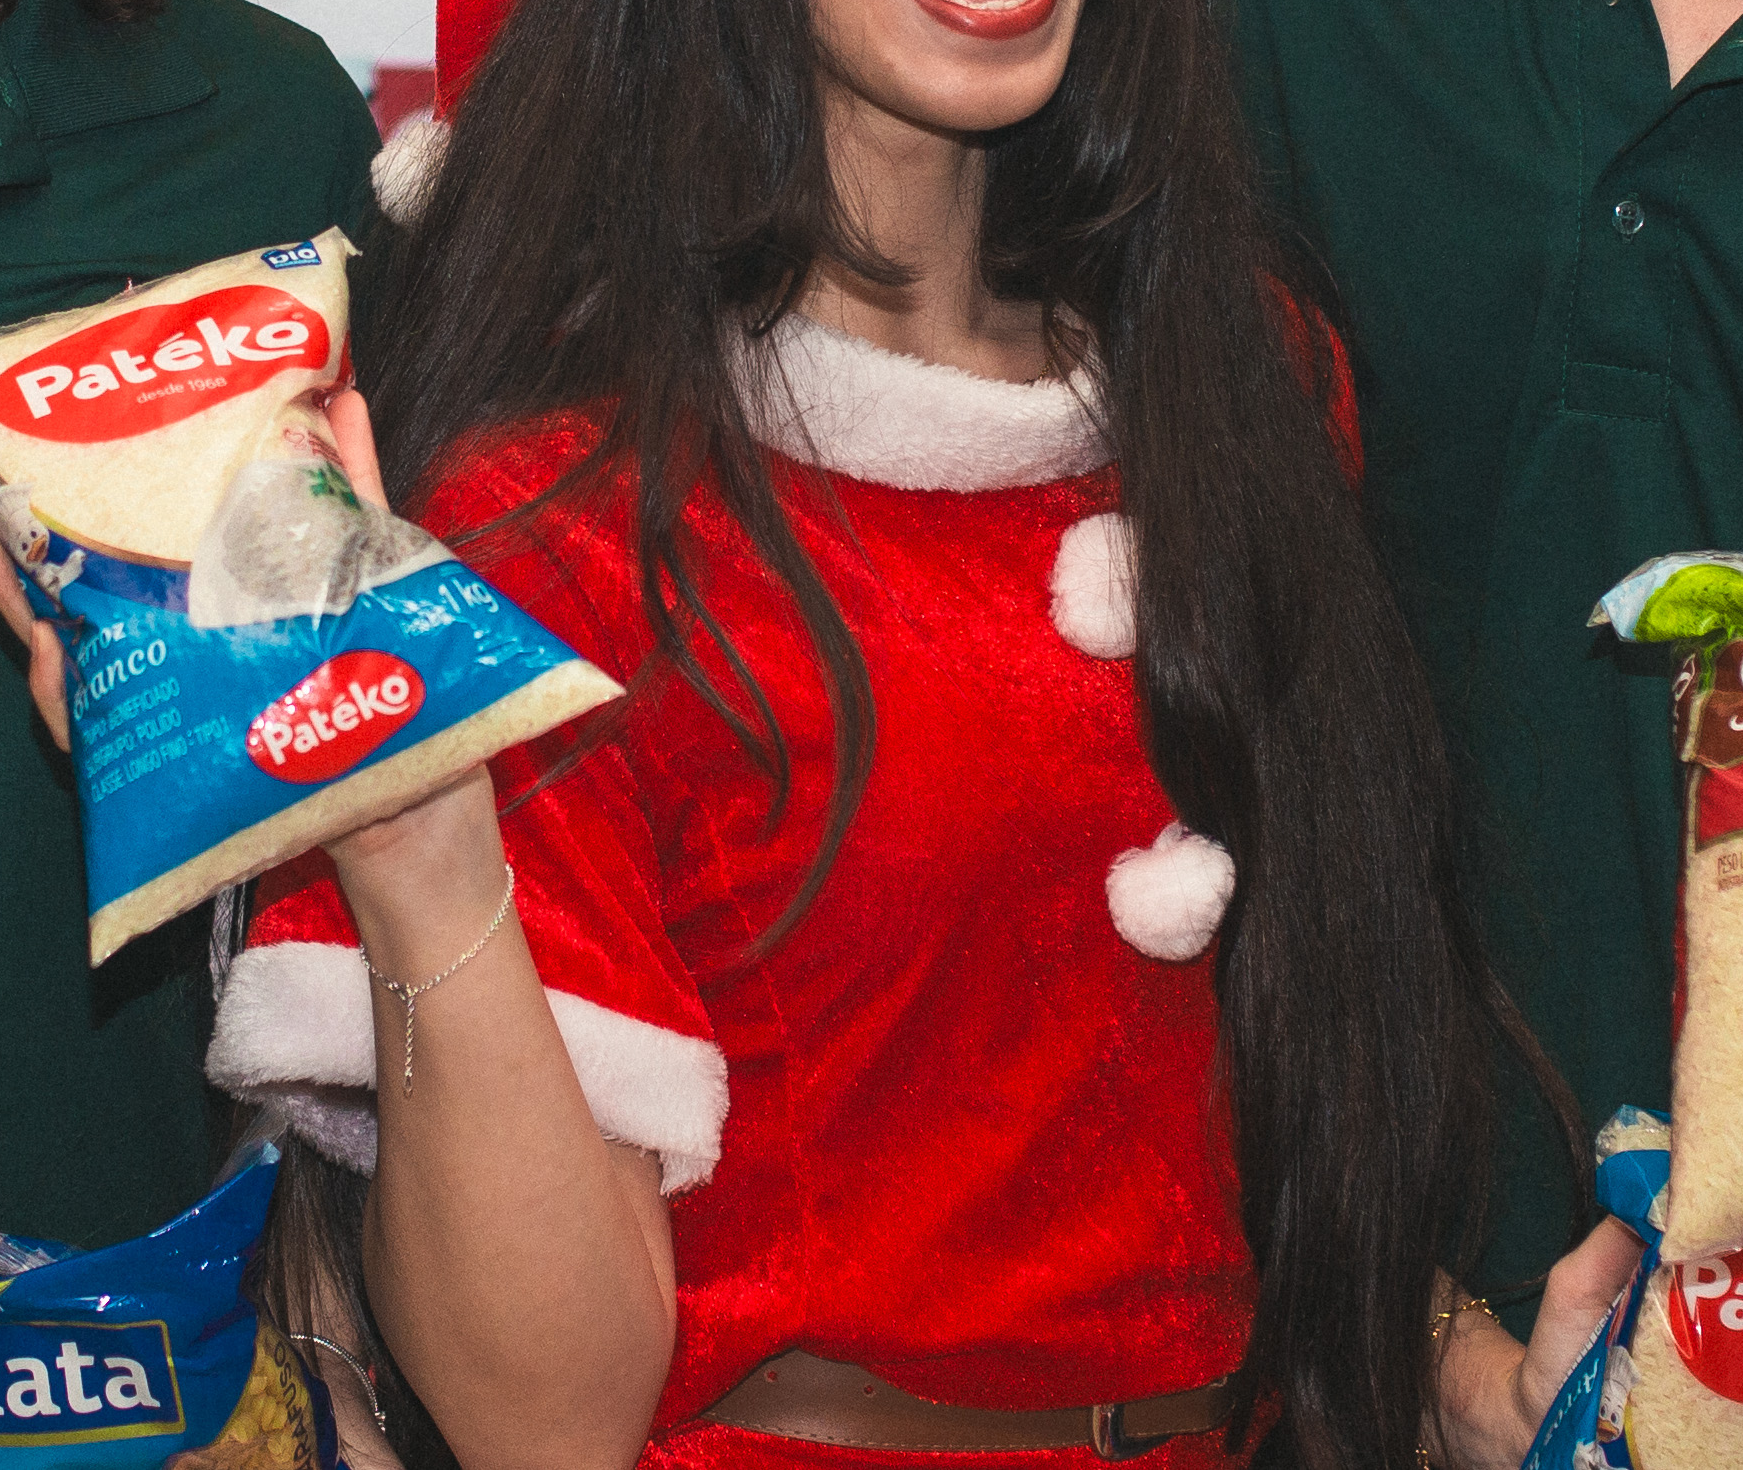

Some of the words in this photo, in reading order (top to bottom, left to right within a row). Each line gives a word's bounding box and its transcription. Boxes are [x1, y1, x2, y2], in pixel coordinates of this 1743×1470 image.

[16, 317, 310, 420] Patéko
[136, 380, 184, 404] desde
[187, 375, 228, 393] 1968
[451, 576, 499, 613] kg
[261, 675, 411, 766] Patéko
[274, 1342, 314, 1470] ARAFUSO
